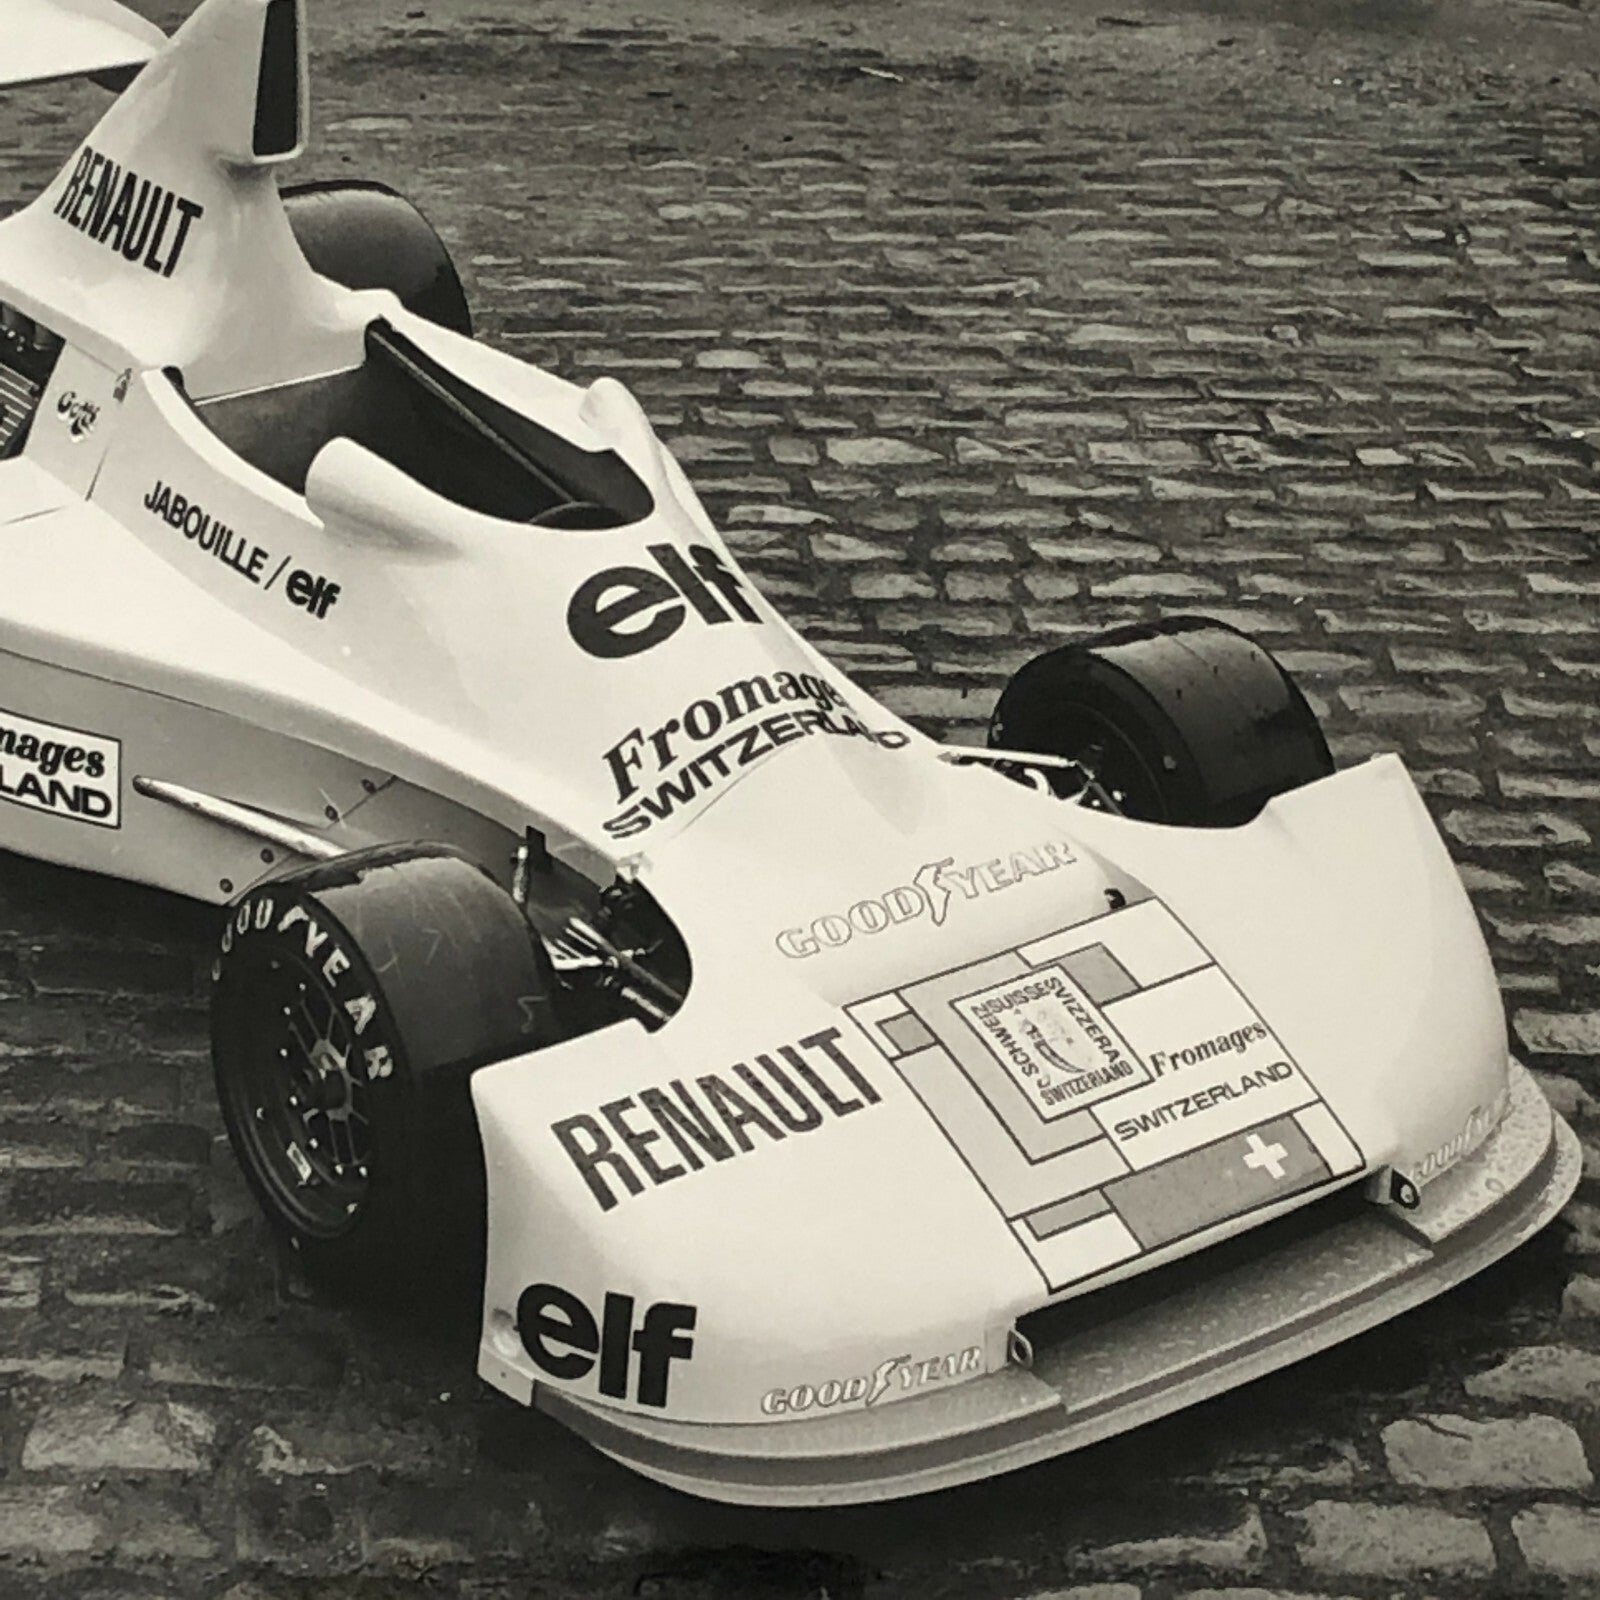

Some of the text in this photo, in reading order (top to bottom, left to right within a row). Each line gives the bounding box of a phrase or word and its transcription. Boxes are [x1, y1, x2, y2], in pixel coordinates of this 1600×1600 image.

[53, 146, 203, 278] RENAULT
[144, 481, 269, 583] JABOUILLE
[286, 569, 341, 619] elf
[567, 543, 764, 658] elf
[602, 710, 911, 839] SWITZERLAND
[603, 671, 857, 804] Fromage
[971, 1004, 1039, 1077] SCHWEIZ
[986, 980, 1051, 1014] SUISSE
[1046, 976, 1121, 1062] SVIZZERA
[1149, 1022, 1267, 1077] Fromages
[550, 1027, 882, 1212] RENAULT
[1040, 1061, 1134, 1106] SWITZERLAND
[1114, 1062, 1293, 1142] SWITZERLAND
[516, 1283, 697, 1408] elf
